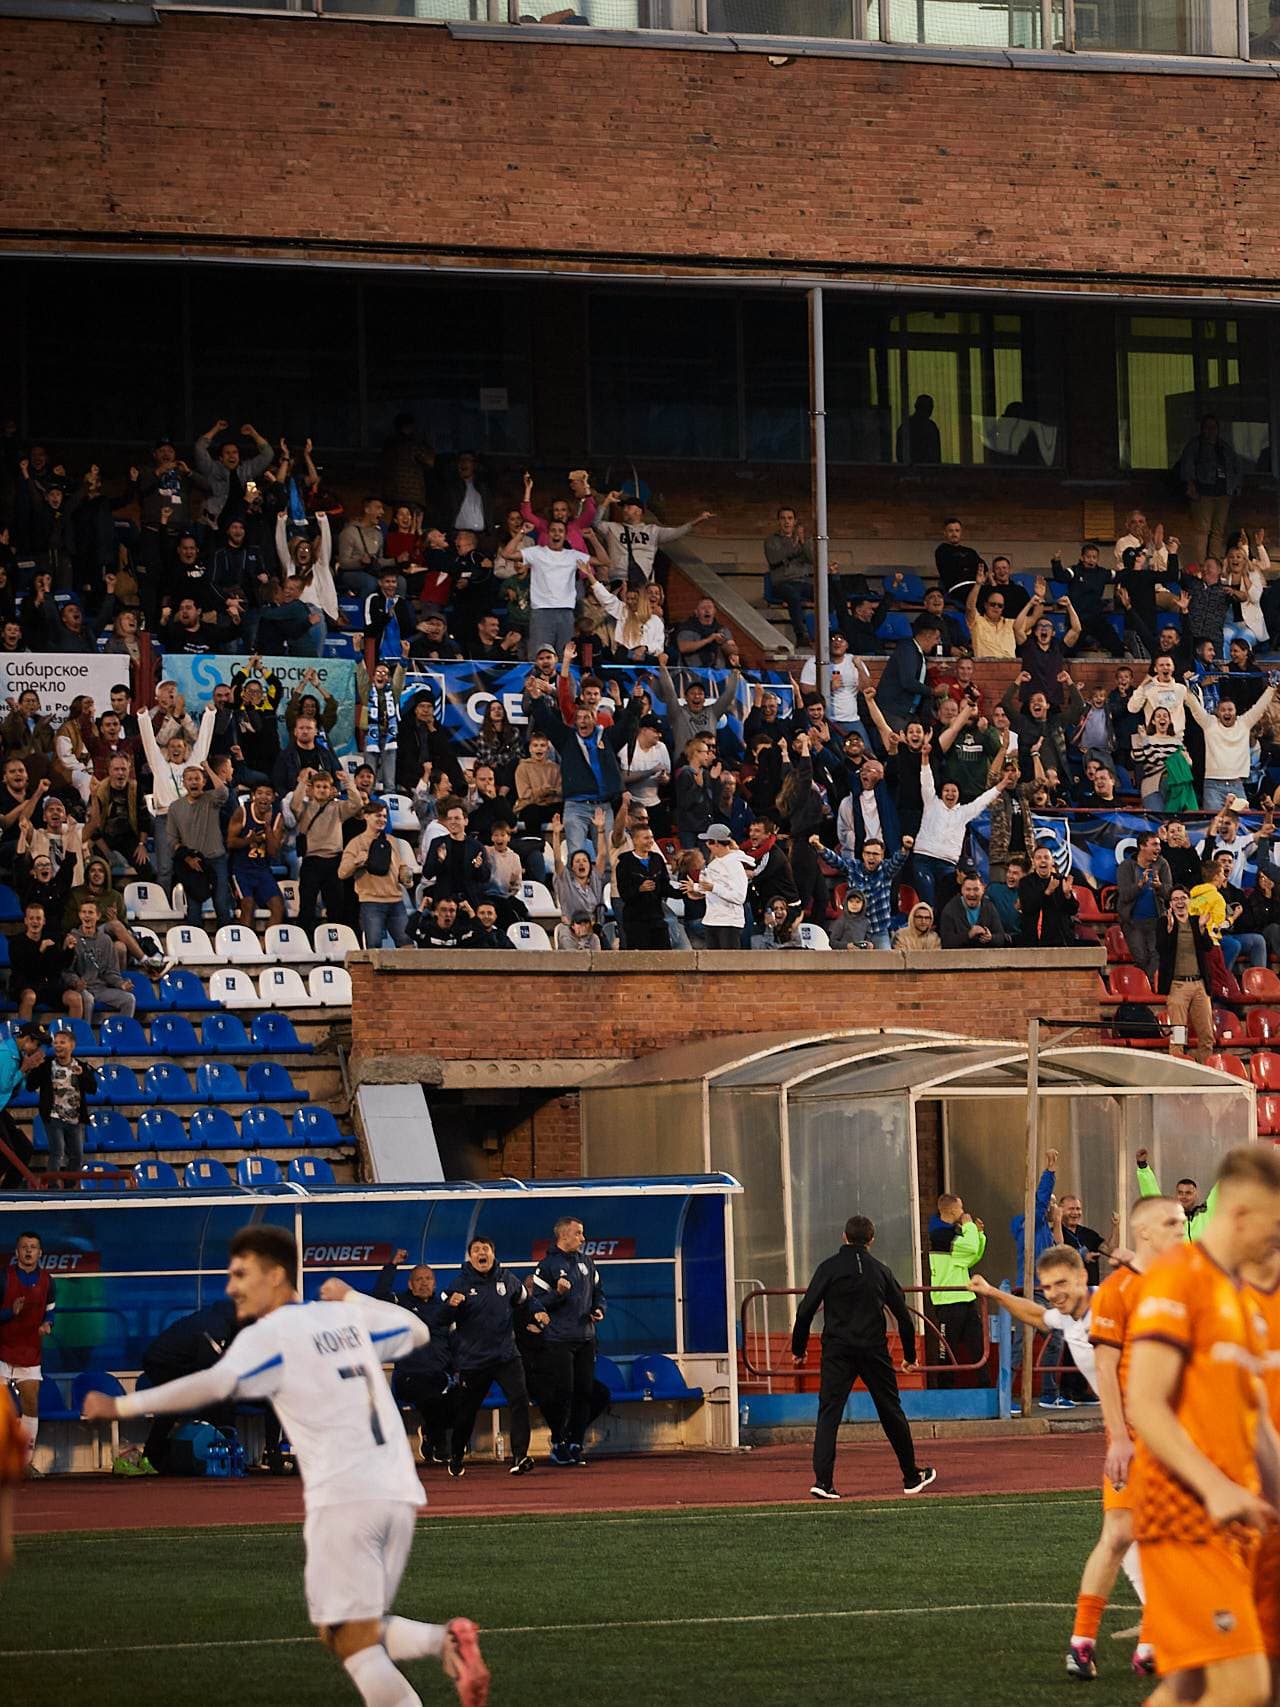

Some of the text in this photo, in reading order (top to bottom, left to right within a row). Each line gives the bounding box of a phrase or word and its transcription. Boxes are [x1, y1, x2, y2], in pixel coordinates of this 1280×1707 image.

[6, 661, 89, 679] Сибирское
[7, 680, 66, 692] стекло
[303, 1245, 375, 1262] FONBET
[337, 1364, 387, 1446] 7
